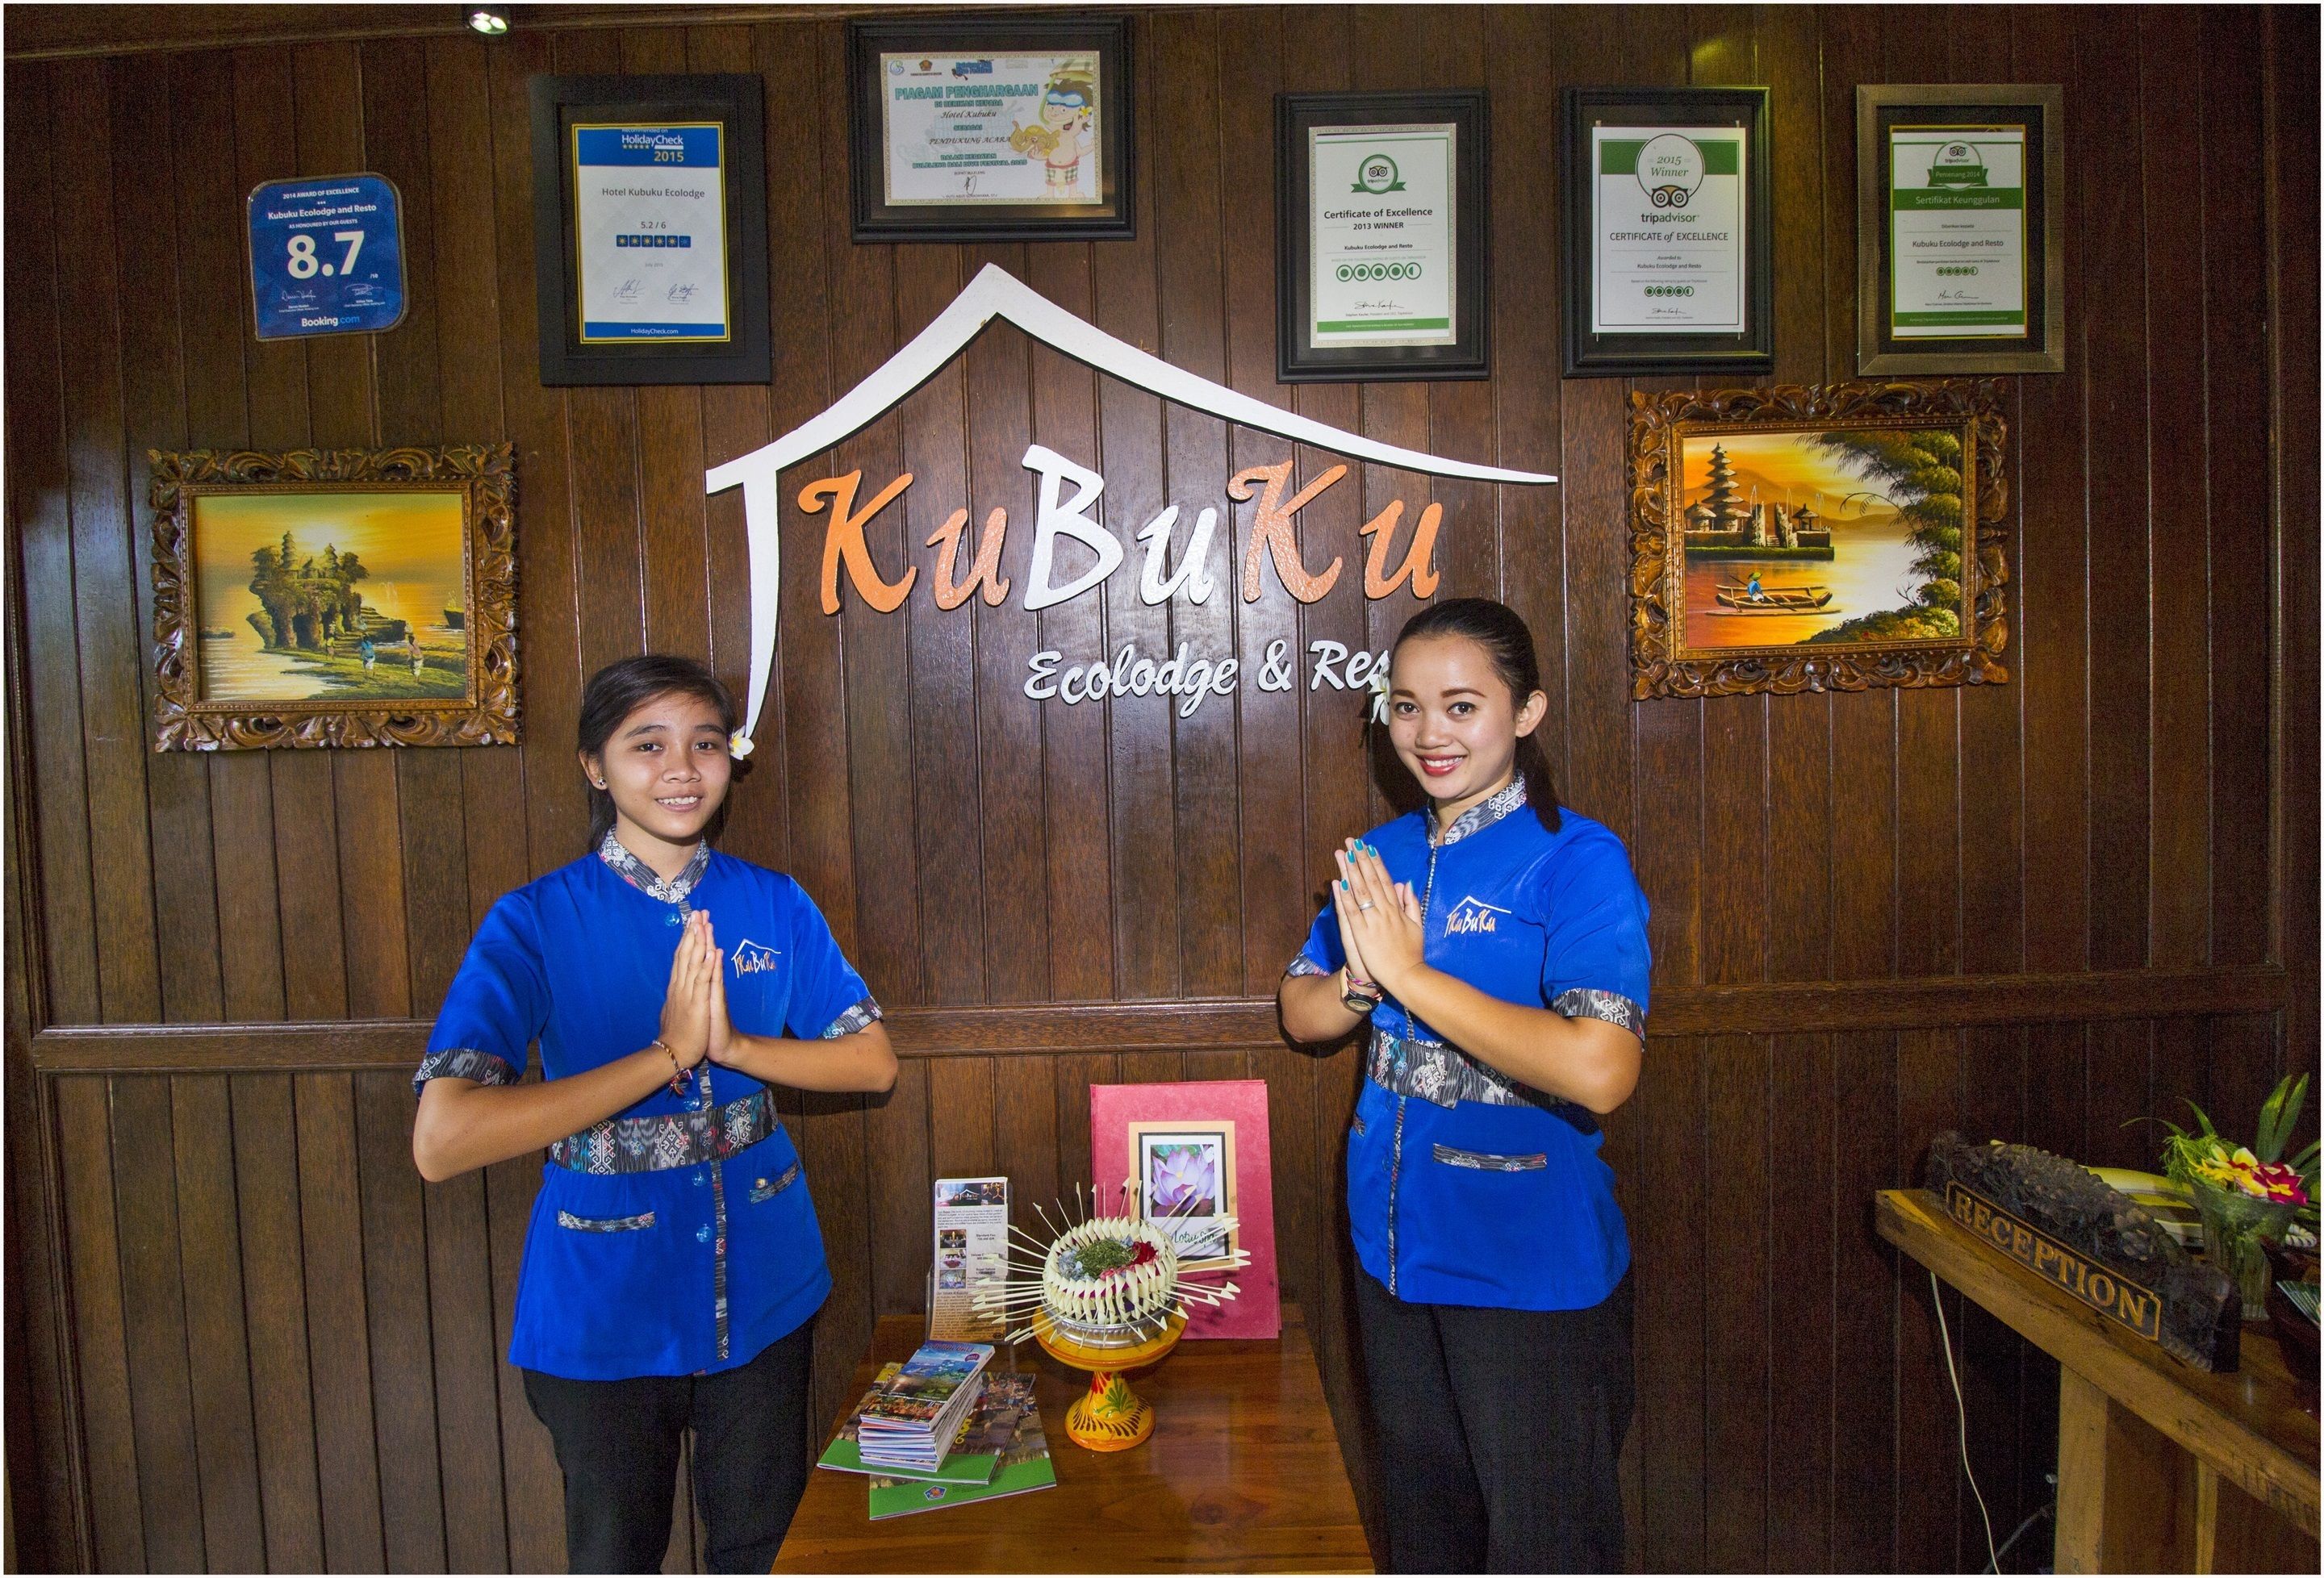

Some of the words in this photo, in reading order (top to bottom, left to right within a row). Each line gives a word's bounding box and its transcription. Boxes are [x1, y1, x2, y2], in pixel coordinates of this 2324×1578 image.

[895, 86, 943, 100] PIAGAM
[946, 83, 1039, 98] PENGHARGAAN
[940, 111, 964, 119] Hotel
[968, 111, 997, 119] Kubuku
[621, 135, 683, 147] HolidayCheck
[930, 137, 981, 145] PENDUKUNG
[654, 151, 684, 162] 2015
[1657, 156, 1682, 165] 2015
[1650, 167, 1689, 177] Winner
[1935, 170, 1966, 178] Pemenang
[326, 187, 360, 196] EXCELLENCE
[602, 187, 626, 197] Hotel
[629, 187, 663, 198] Kubuku
[665, 188, 705, 199] Ecolodge
[1916, 195, 1952, 205] Sertifikat
[1954, 195, 2000, 206] Keunggulan
[268, 210, 299, 220] Kubuku
[299, 207, 336, 219] Ecolodge
[337, 205, 353, 214] and
[354, 204, 377, 212] Resto
[1323, 211, 1371, 219] Certificate
[1373, 209, 1384, 218] of
[1386, 207, 1433, 217] Excellence
[1641, 213, 1697, 224] tripadvisor
[641, 221, 653, 229] 5.2
[661, 221, 667, 229] 6
[1353, 223, 1372, 231] 2013
[1373, 221, 1404, 229] WINNER
[1609, 232, 1662, 241] CERTIFICATE
[1664, 232, 1674, 243] of
[1677, 232, 1728, 241] EXCELLENCE
[1912, 240, 1937, 248] Kubuku
[1939, 239, 1970, 248] Ecolodge
[1971, 239, 1983, 247] and
[1985, 239, 2004, 247] Resto
[287, 231, 365, 279] 8.7
[630, 328, 679, 336] HolidayCheck.com
[797, 443, 1444, 616] KuBuKu
[1022, 641, 1239, 720] Ecolodge
[1257, 639, 1291, 692] &
[1309, 640, 1391, 693] Res
[1448, 908, 1496, 935] KuBuKu
[1954, 1191, 2147, 1328] RECEPTION
